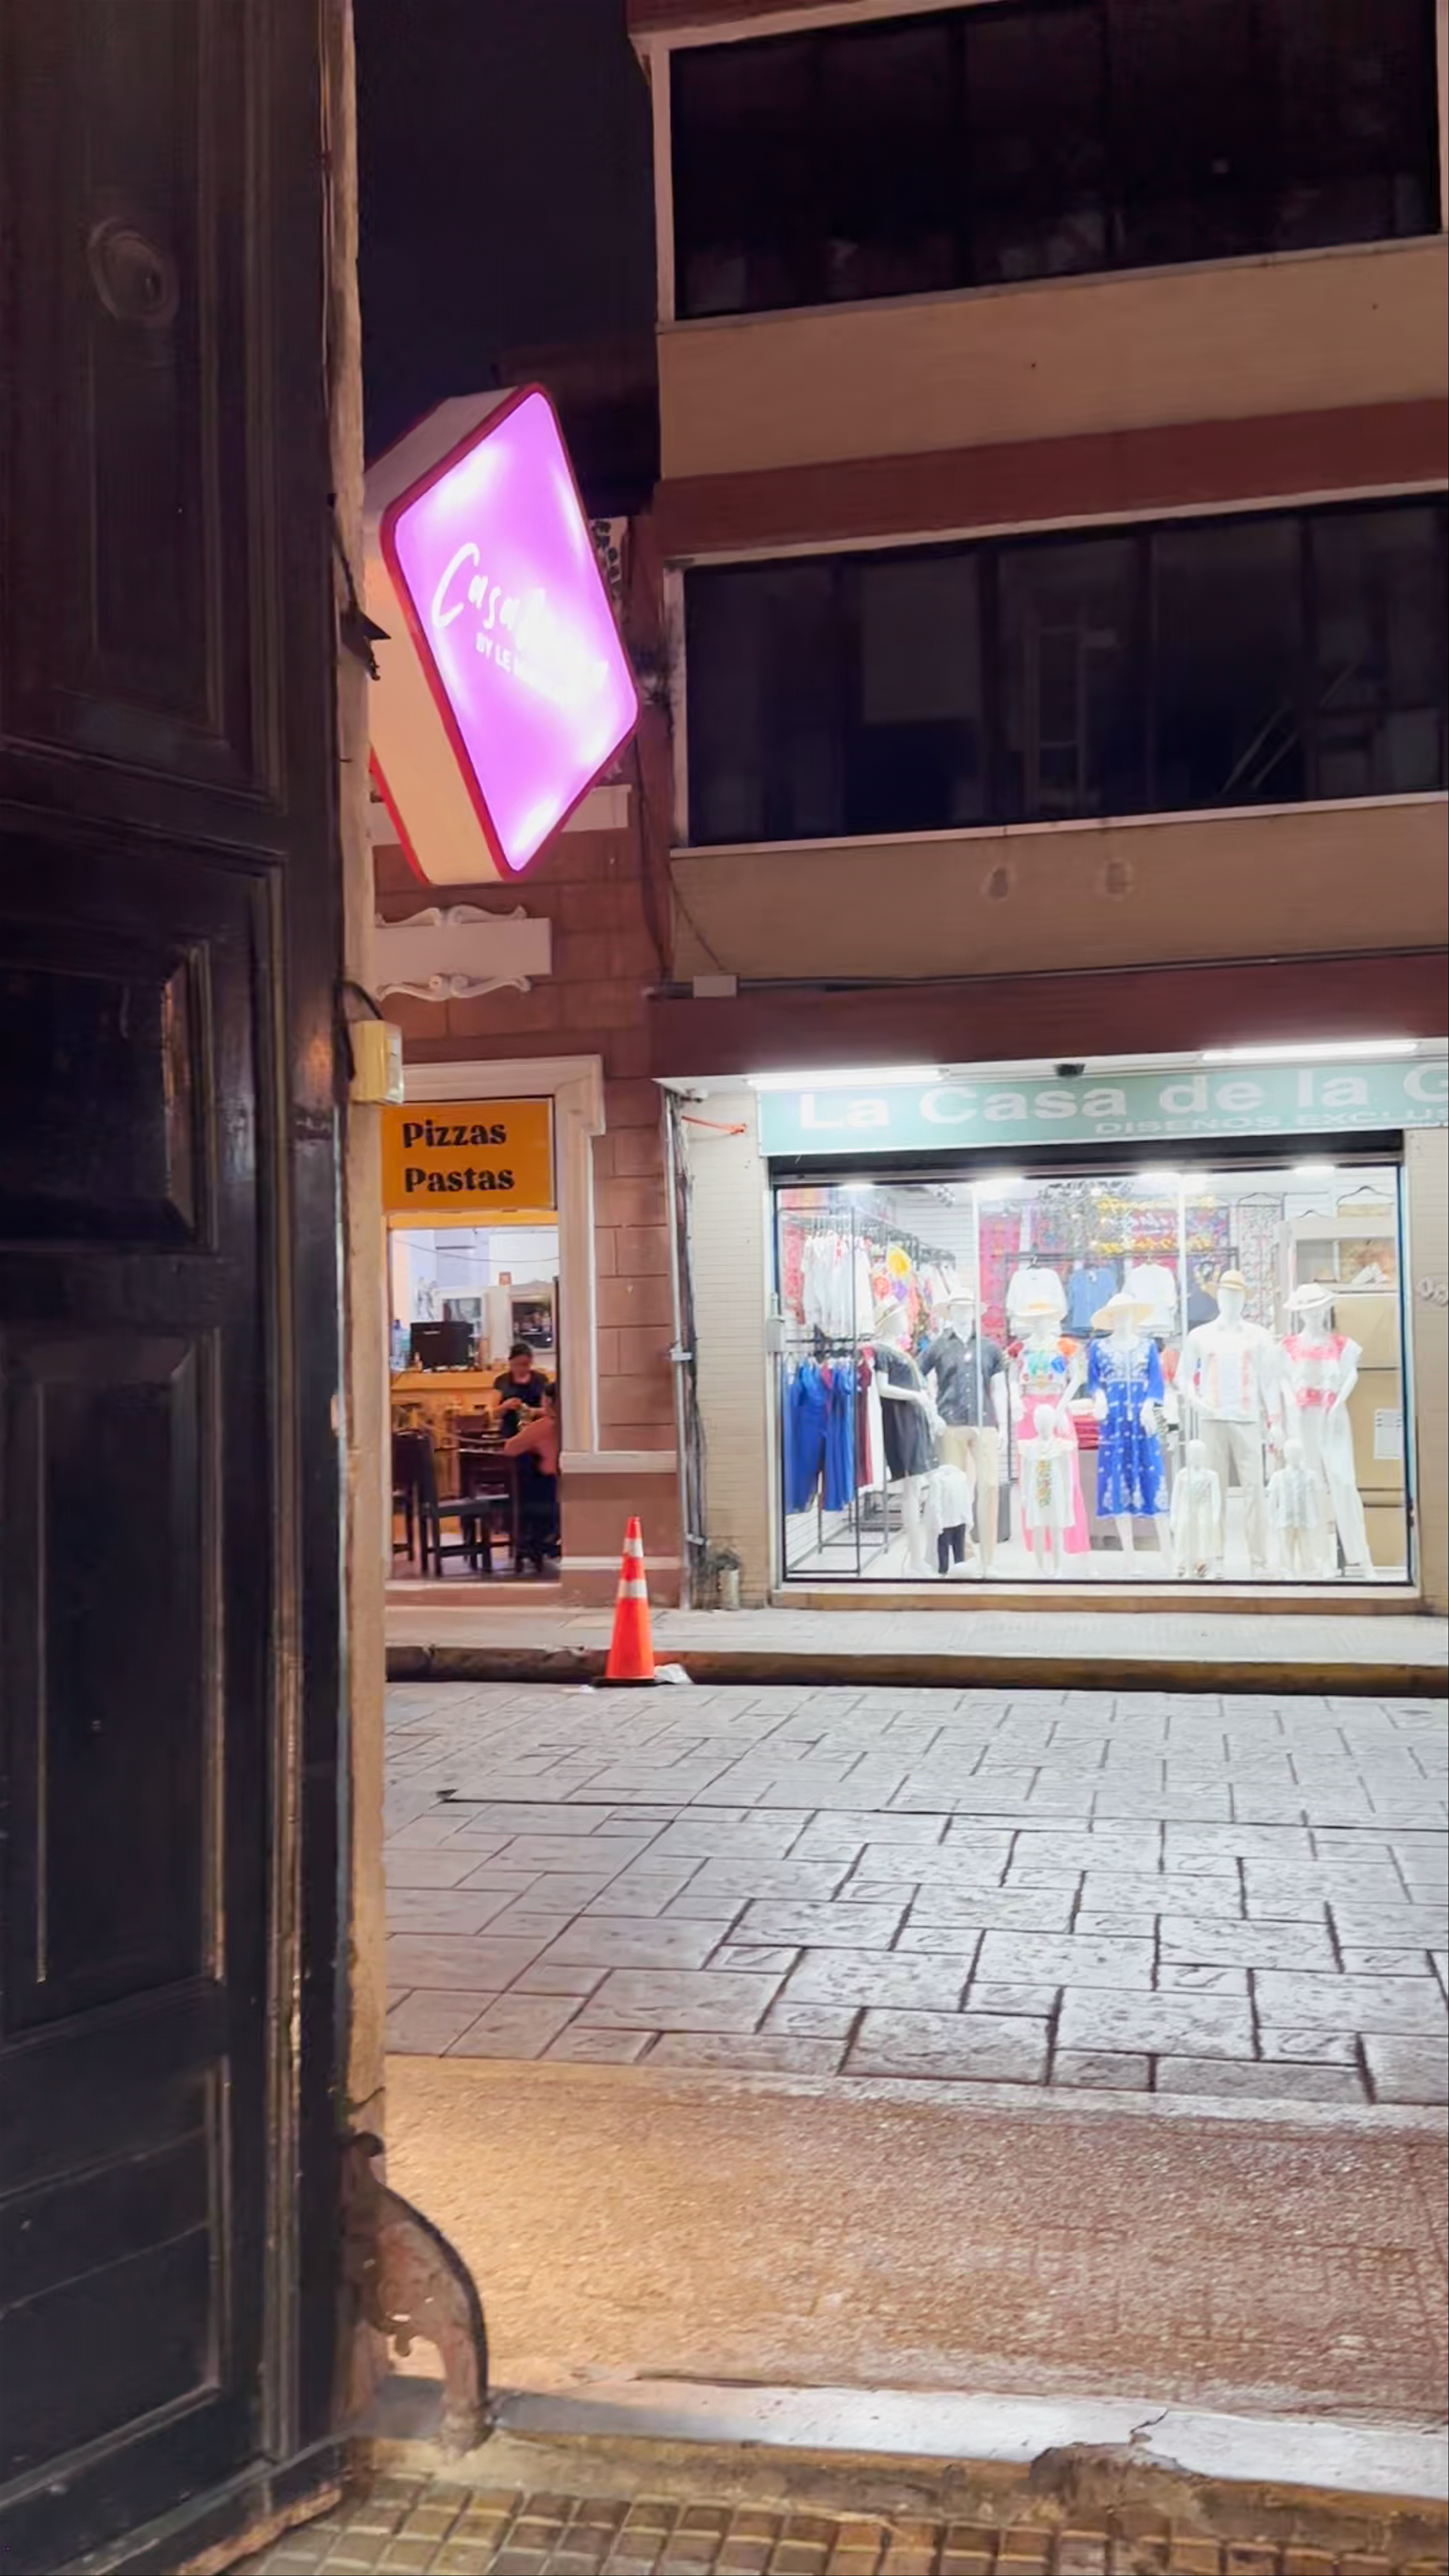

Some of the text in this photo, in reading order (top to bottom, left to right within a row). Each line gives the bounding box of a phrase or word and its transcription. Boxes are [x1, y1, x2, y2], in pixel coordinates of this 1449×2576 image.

[800, 1093, 890, 1128] La
[919, 1086, 1127, 1124] Casa
[1159, 1074, 1265, 1113] de
[1298, 1069, 1370, 1107] la
[402, 1119, 506, 1148] Pizzas
[405, 1168, 515, 1192] Pastas
